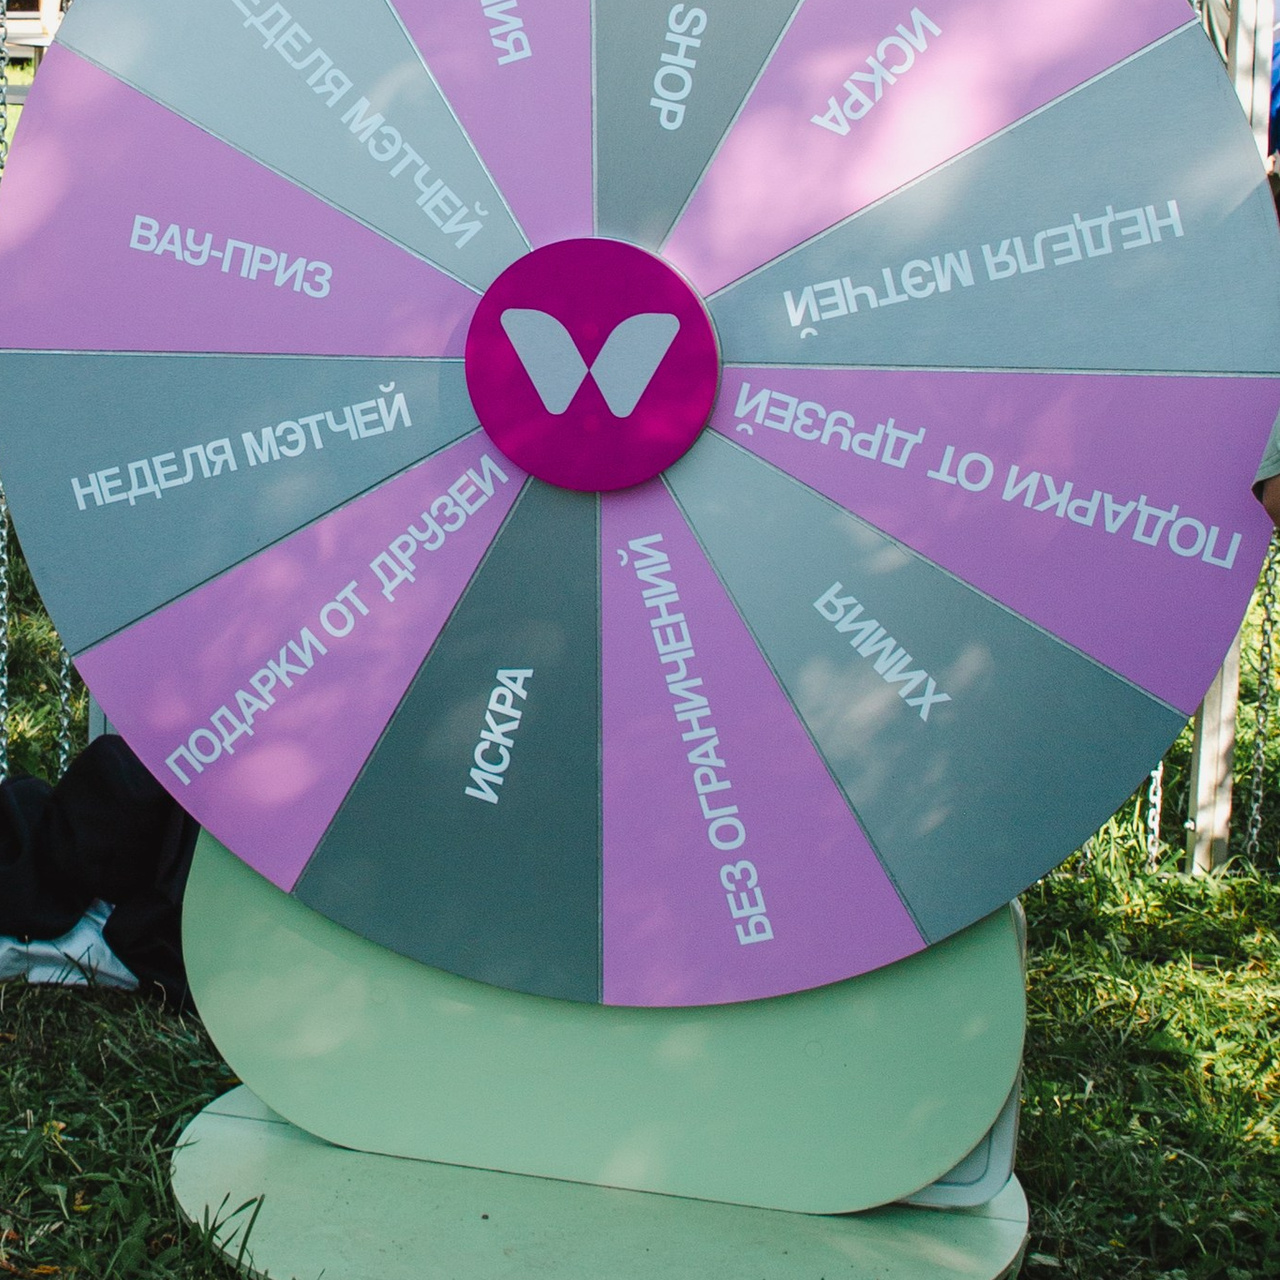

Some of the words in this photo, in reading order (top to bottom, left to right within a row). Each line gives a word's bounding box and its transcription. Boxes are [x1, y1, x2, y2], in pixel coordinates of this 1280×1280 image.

[649, 3, 708, 131] SHOP
[810, 6, 942, 136] ИСКРА
[340, 96, 487, 249] МЭТЧЕЙ
[129, 214, 333, 299] ВАУ-ПРИЗ
[783, 249, 970, 339] МЭТЧЕЙ
[982, 199, 1184, 279] НЕДЕЛЯ
[70, 437, 238, 511] НЕДЕЛЯ
[241, 381, 412, 467] МЭТЧЕЙ
[733, 381, 927, 469] ДРУЗЕЙ
[926, 444, 995, 492] ОТ
[1001, 464, 1243, 570] ПОДАРКИ
[164, 625, 329, 786] ПОДАРКИ
[319, 580, 370, 638] ОТ
[616, 532, 747, 851] ОГРАНИЧЕНИЙ
[813, 581, 952, 722] ХИМИЯ
[464, 668, 534, 805] ИСКРА
[719, 859, 775, 946] БЕЗ
